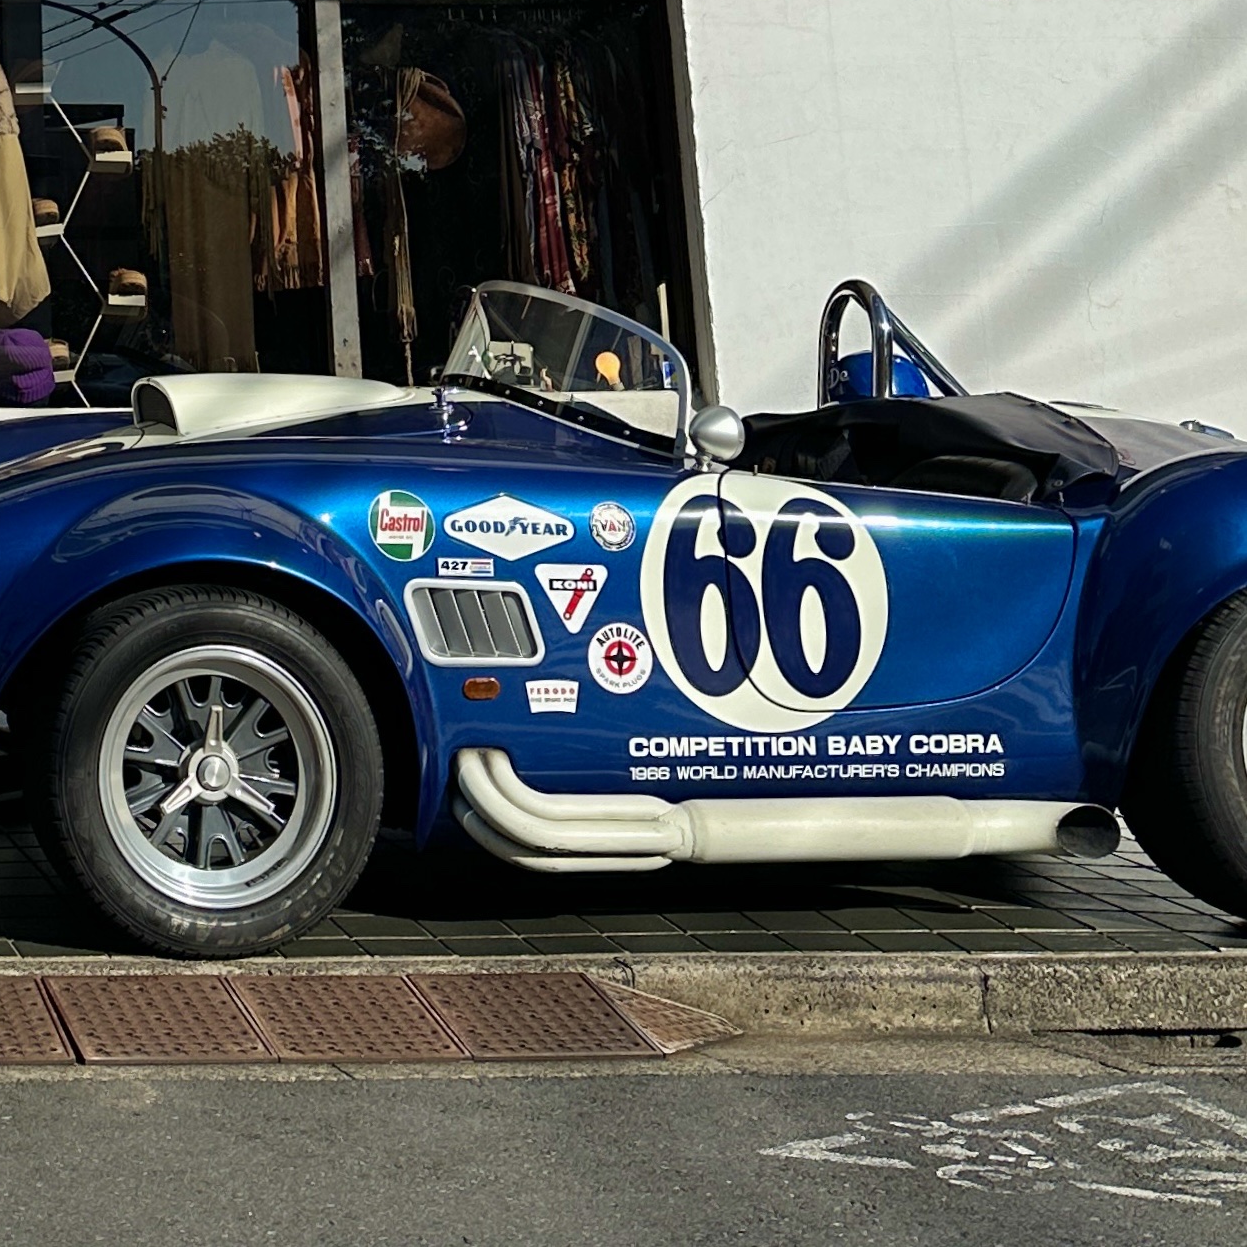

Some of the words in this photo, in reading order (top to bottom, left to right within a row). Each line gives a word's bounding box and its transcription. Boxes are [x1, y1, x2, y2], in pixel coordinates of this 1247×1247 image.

[380, 508, 425, 532] Castrol
[441, 561, 468, 570] 427
[552, 580, 594, 590] KONI
[663, 494, 862, 698] 66
[596, 626, 646, 650] AUTOLITE
[595, 667, 621, 688] SPARK
[530, 687, 575, 695] FERODO
[628, 736, 817, 758] COMPETITION
[826, 734, 902, 756] BABY
[909, 733, 1005, 755] COBRA
[629, 766, 670, 781] 1966
[676, 765, 737, 780] WORLD
[743, 763, 900, 779] MANUFACTURER'S
[905, 763, 1005, 778] CHAMPIONS
